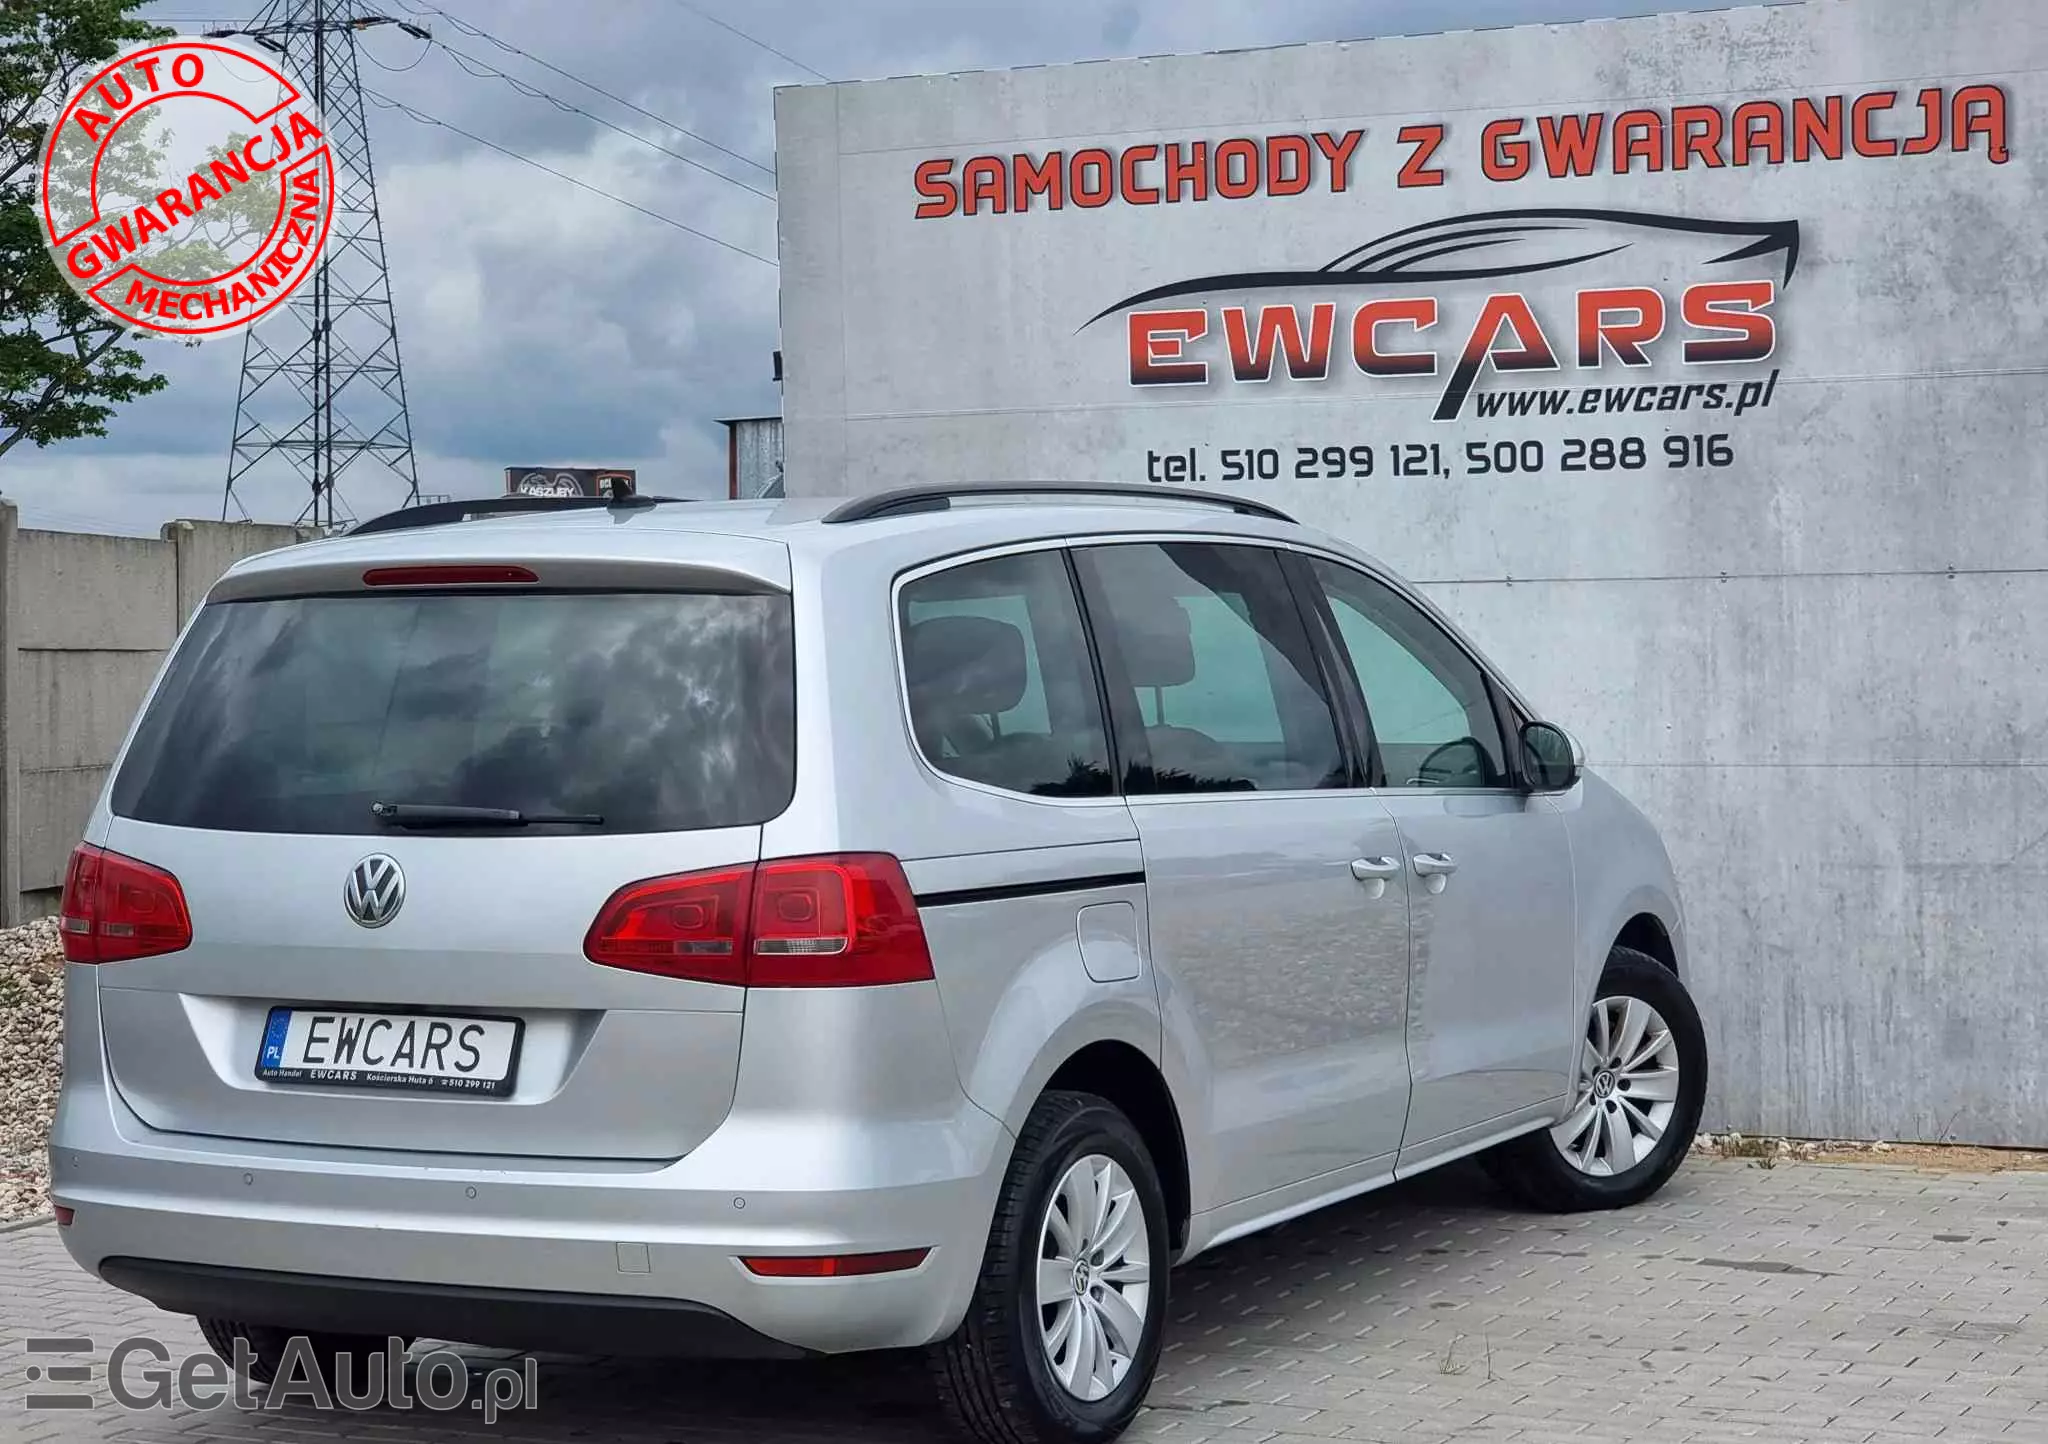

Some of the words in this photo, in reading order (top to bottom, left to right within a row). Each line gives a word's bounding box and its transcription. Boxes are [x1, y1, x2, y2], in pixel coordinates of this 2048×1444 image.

[914, 129, 1365, 220] SAMOCHODY
[1397, 123, 1445, 188] Z
[1480, 84, 2011, 182] GWARANCJĄ
[1128, 280, 1775, 422] EWCARS
[1476, 369, 1780, 418] www.ewcars.pl
[1147, 448, 1206, 483] tel.
[1222, 448, 1279, 480] 510
[1296, 446, 1373, 478] 299
[1390, 444, 1450, 480] 121,
[1465, 440, 1544, 475] 500
[1560, 437, 1647, 472] 288
[1663, 433, 1734, 469] 916
[266, 1046, 281, 1060] PL
[303, 1016, 485, 1073] EWCARS
[262, 1069, 278, 1077] Auto
[310, 1070, 357, 1081] EWCARS
[408, 1077, 427, 1085] Huta
[448, 1080, 463, 1088] 510
[464, 1080, 480, 1089] 299
[482, 1082, 496, 1090] 121
